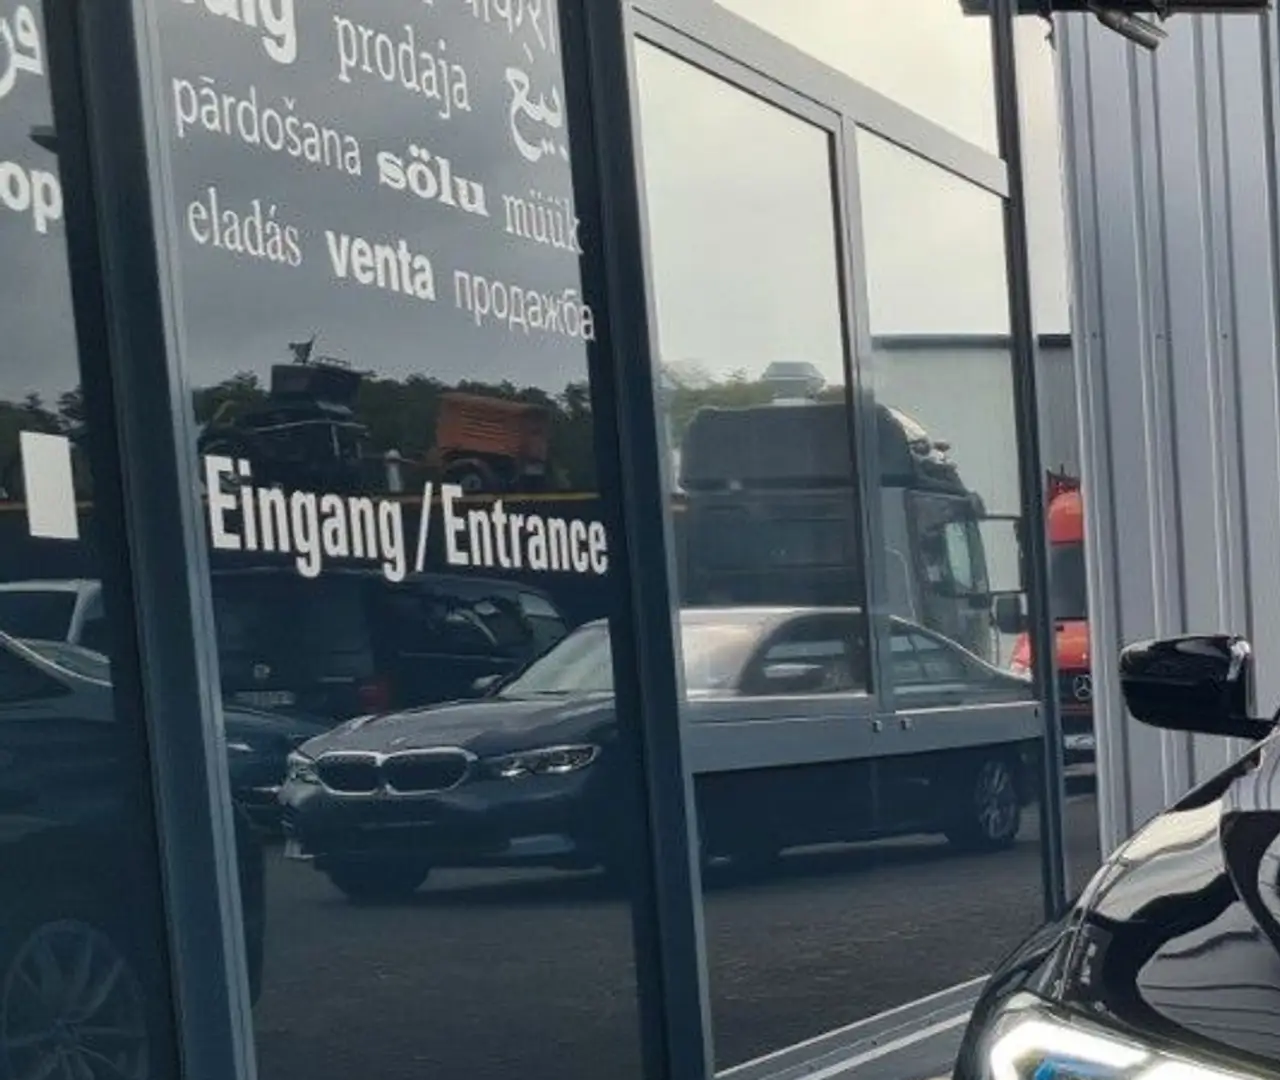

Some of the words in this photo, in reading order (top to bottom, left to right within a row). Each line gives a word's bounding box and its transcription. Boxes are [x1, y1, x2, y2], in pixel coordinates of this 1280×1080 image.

[333, 15, 472, 120] prodaja
[172, 74, 362, 177] pārdošana
[376, 143, 491, 217] sölu
[502, 189, 585, 254] müük
[187, 185, 302, 267] eladás
[325, 229, 436, 301] venta
[453, 269, 595, 341] продажба
[204, 453, 406, 582] Eingang
[441, 483, 609, 574] Entrance
